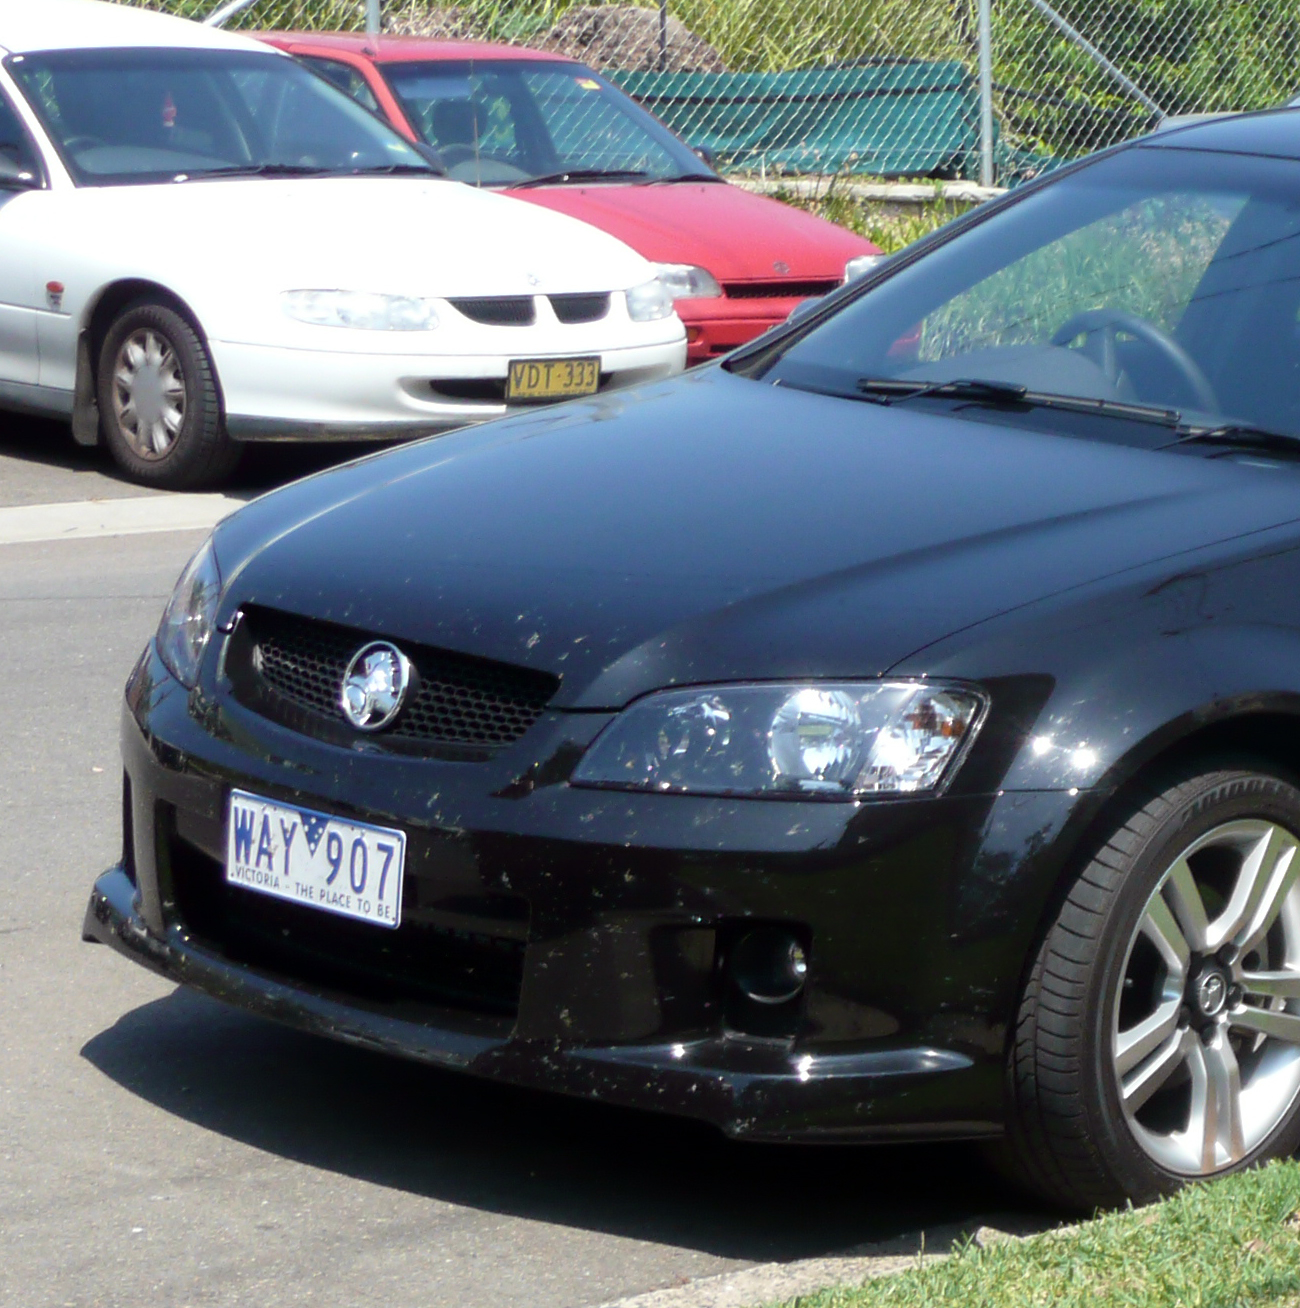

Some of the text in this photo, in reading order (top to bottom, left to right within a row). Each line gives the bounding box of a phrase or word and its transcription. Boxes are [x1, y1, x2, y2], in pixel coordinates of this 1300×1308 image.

[234, 806, 395, 901] WAY 907
[235, 865, 280, 888] VICTORIA
[295, 882, 314, 900] THE
[320, 889, 351, 909] PLACE
[357, 898, 371, 914] TO
[377, 903, 391, 920] BE
